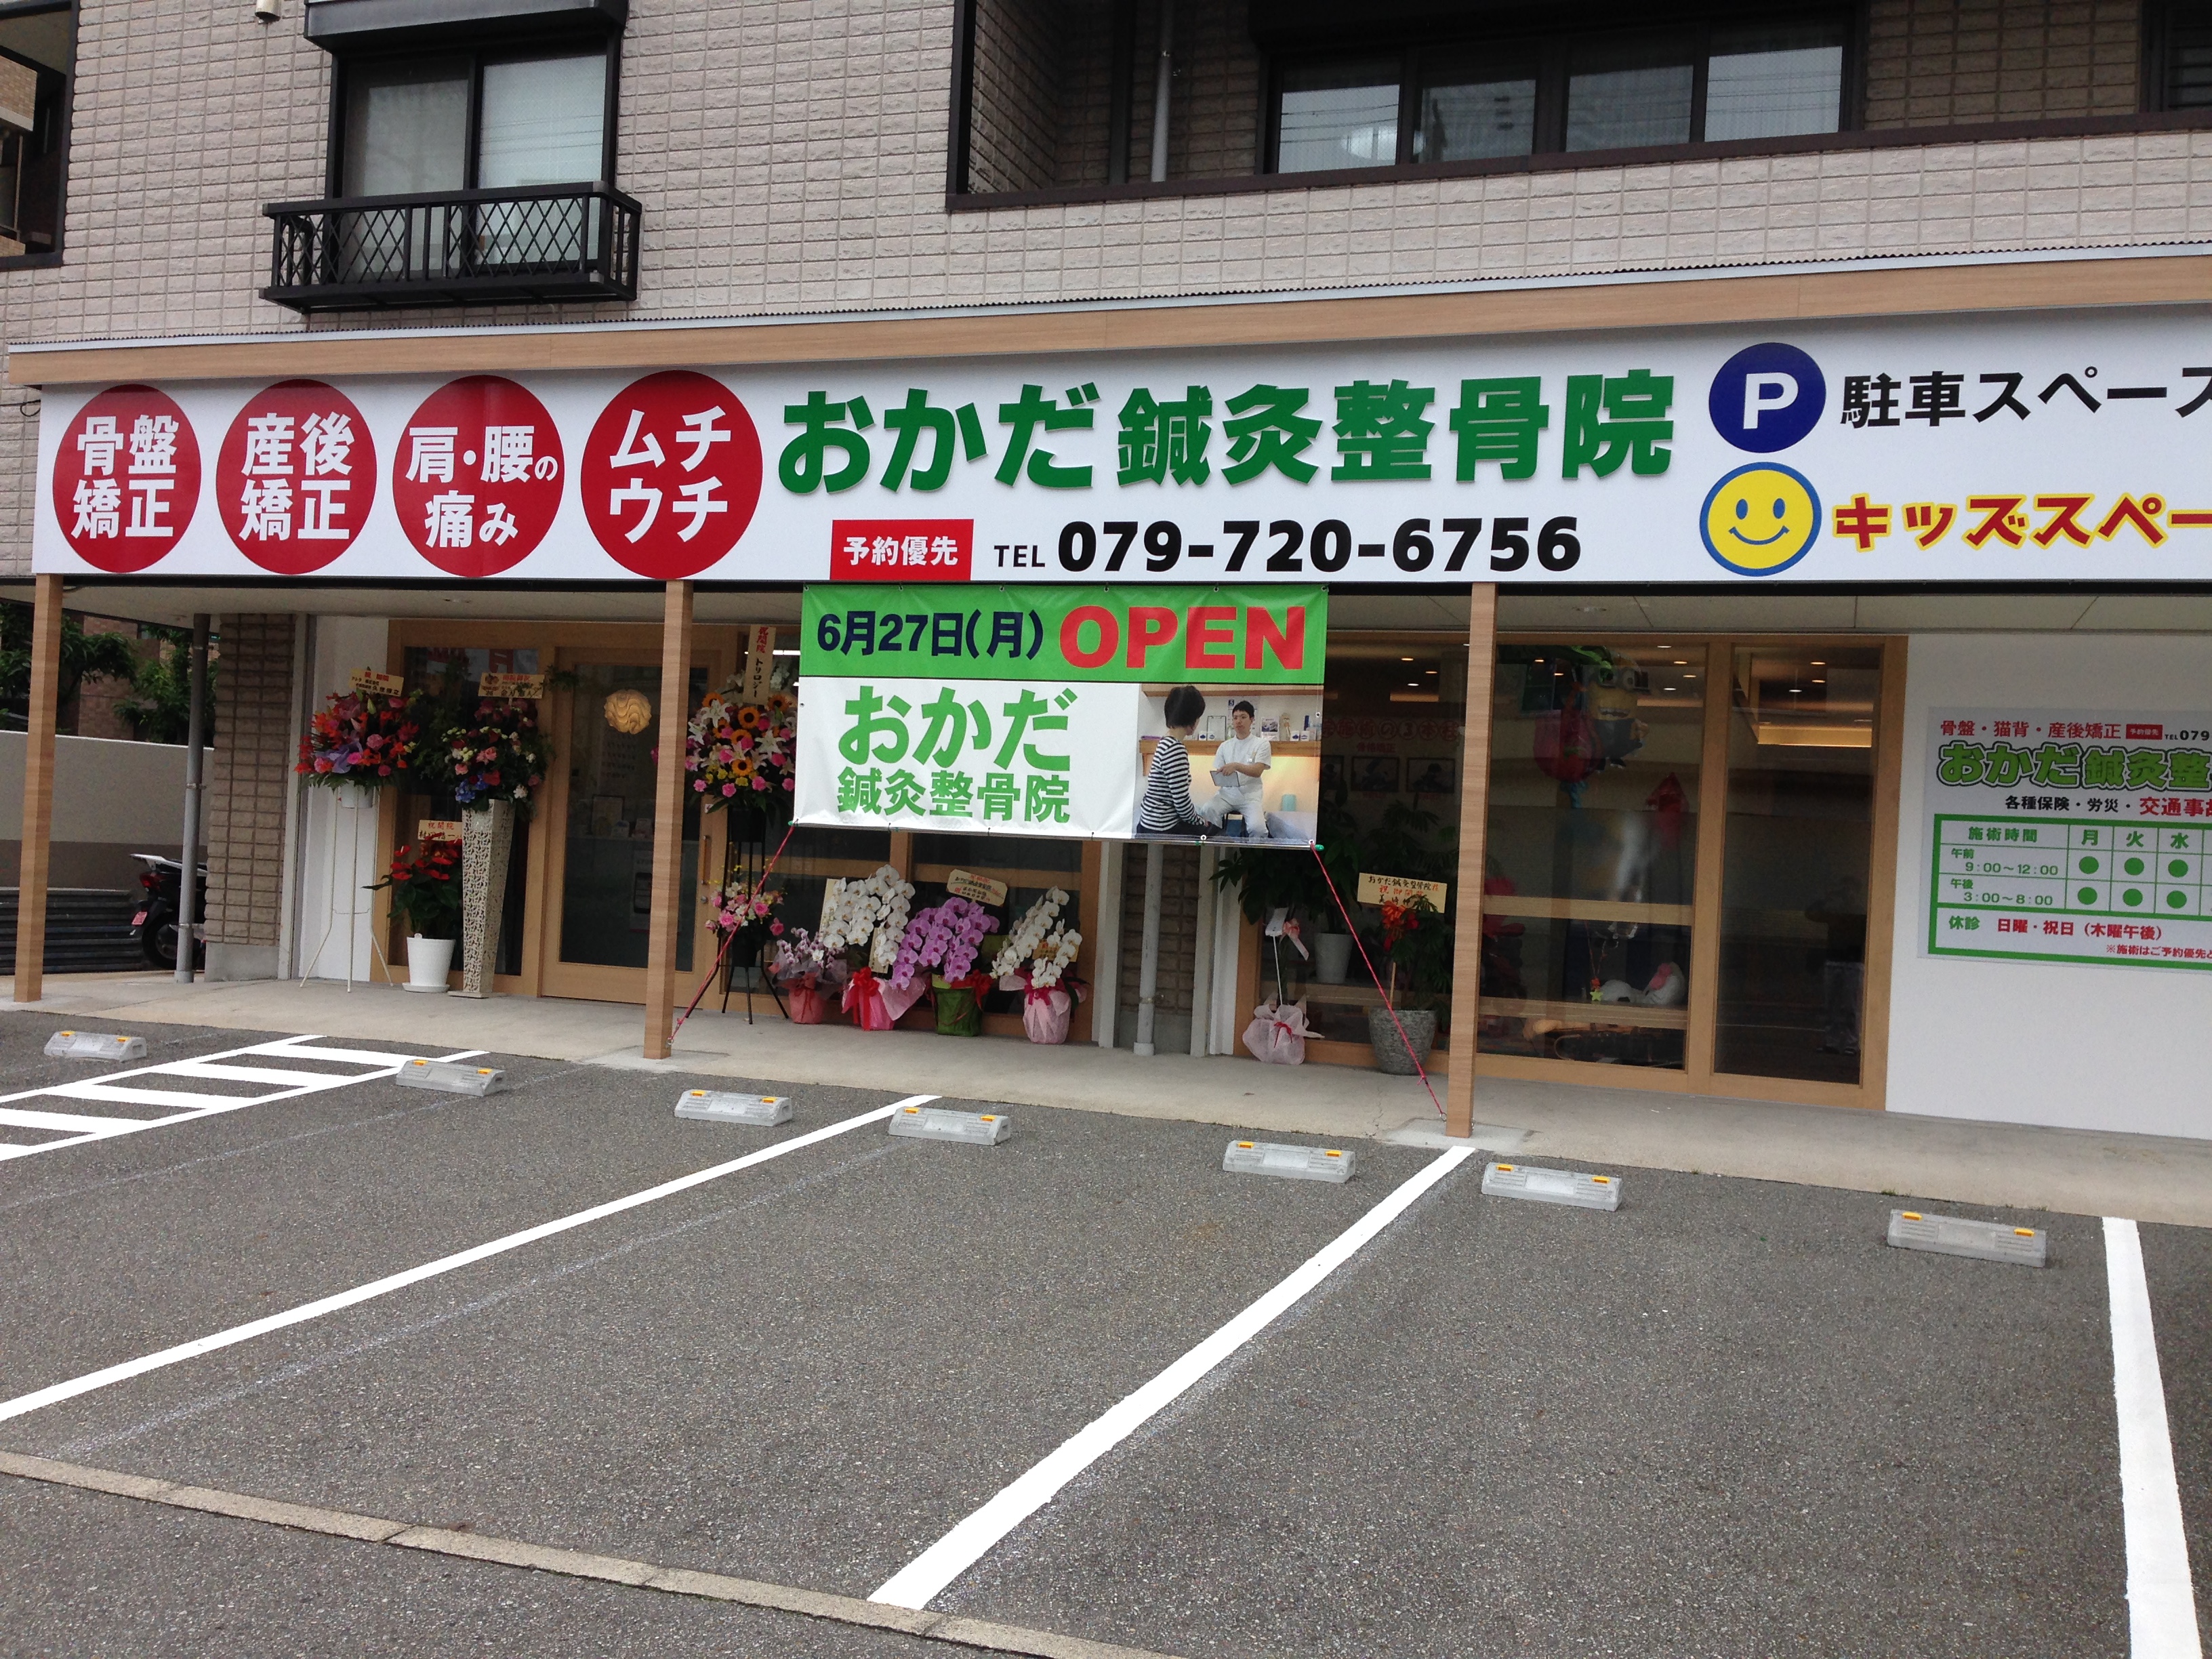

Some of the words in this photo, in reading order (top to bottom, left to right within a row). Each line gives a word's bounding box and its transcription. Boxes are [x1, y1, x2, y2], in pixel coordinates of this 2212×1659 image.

[1742, 372, 1799, 429] P
[77, 414, 179, 476] 骨盤
[241, 413, 354, 476] 産後
[407, 425, 558, 484] 肩・腰の
[609, 405, 731, 472] ムチ
[779, 369, 1674, 494] おかだ鍼灸整骨院
[71, 478, 174, 539] 矯正
[239, 479, 350, 541] 矯正
[425, 490, 518, 549] 痛み
[609, 475, 728, 543] ウチ
[1835, 493, 2212, 551] キッズスペー
[843, 535, 959, 567] 予約優先
[994, 545, 1046, 568] TEL
[1058, 516, 1582, 573] 079-720-6756
[817, 609, 1044, 660] 6月27日(月)
[1059, 605, 1306, 670] OPEN
[838, 684, 1078, 772] おかだ
[1940, 720, 2121, 739] 骨盤・猫背・産後矯正
[837, 766, 1071, 824] 鍼灸整骨院
[1951, 848, 1975, 859] 午前
[1968, 826, 2037, 843] 施術時間
[2081, 829, 2098, 846] 月
[2126, 831, 2144, 847] 火
[2170, 832, 2189, 849] 水
[1950, 878, 1973, 890] 午後
[1948, 915, 1980, 930] 休診
